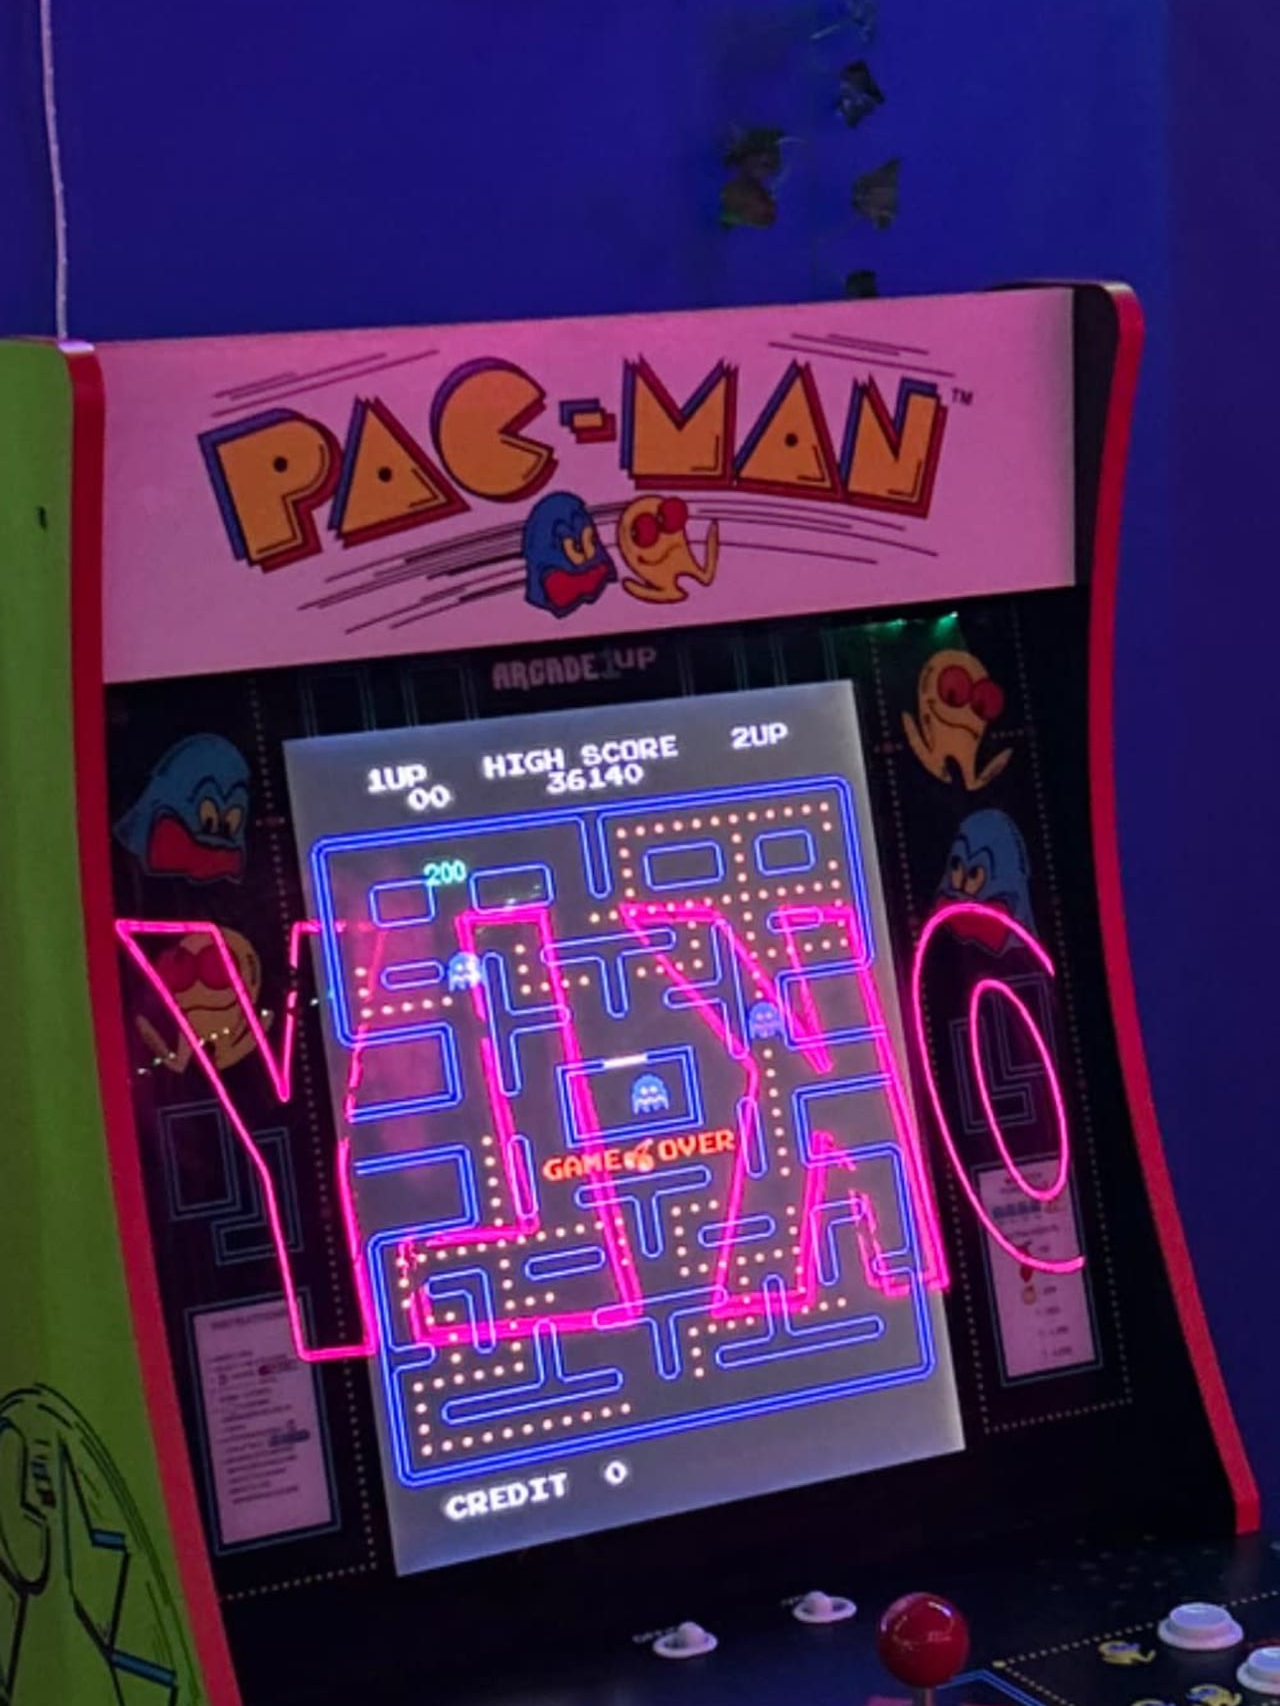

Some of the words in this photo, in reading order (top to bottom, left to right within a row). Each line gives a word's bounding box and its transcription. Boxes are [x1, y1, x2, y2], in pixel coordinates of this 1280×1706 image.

[197, 351, 948, 573] PAC-MAN
[730, 721, 790, 751] 2UP
[482, 747, 565, 780] HIGH
[581, 733, 680, 767] SCORE
[366, 763, 428, 794] 1UP
[546, 763, 645, 795] 36140
[424, 858, 467, 886] 200
[542, 1147, 622, 1183] GAME
[656, 1127, 736, 1163] OVER
[443, 1470, 569, 1522] CREDIT
